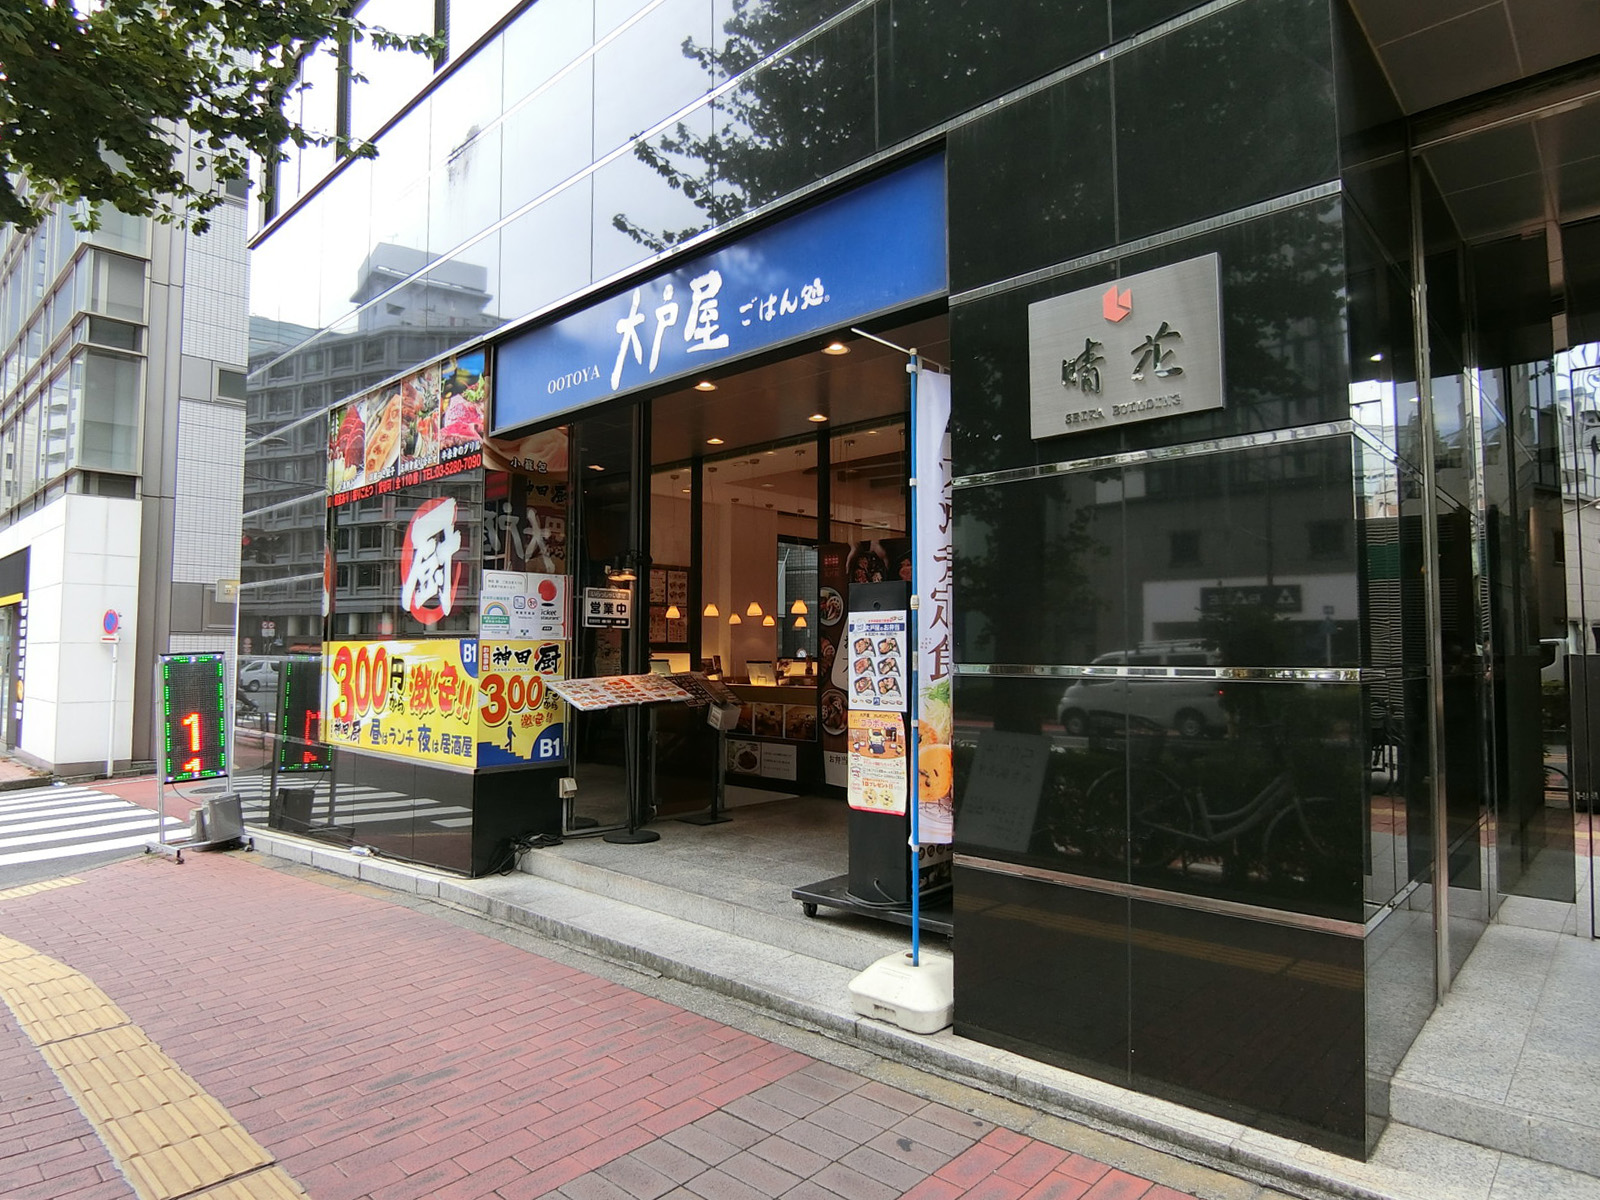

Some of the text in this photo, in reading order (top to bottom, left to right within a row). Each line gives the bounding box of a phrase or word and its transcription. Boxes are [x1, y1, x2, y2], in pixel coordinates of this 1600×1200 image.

[610, 269, 826, 390] 大戸屋 ごはん処
[547, 364, 600, 395] OOTOYA
[1112, 394, 1181, 417] BUILDING
[402, 497, 461, 616] 厨
[590, 601, 627, 616] 営業中
[463, 642, 476, 664] B1
[493, 644, 561, 673] 神田厨
[370, 718, 414, 748] 昼はランチ
[417, 723, 472, 758] 夜は居酒屋
[540, 738, 560, 758] B1
